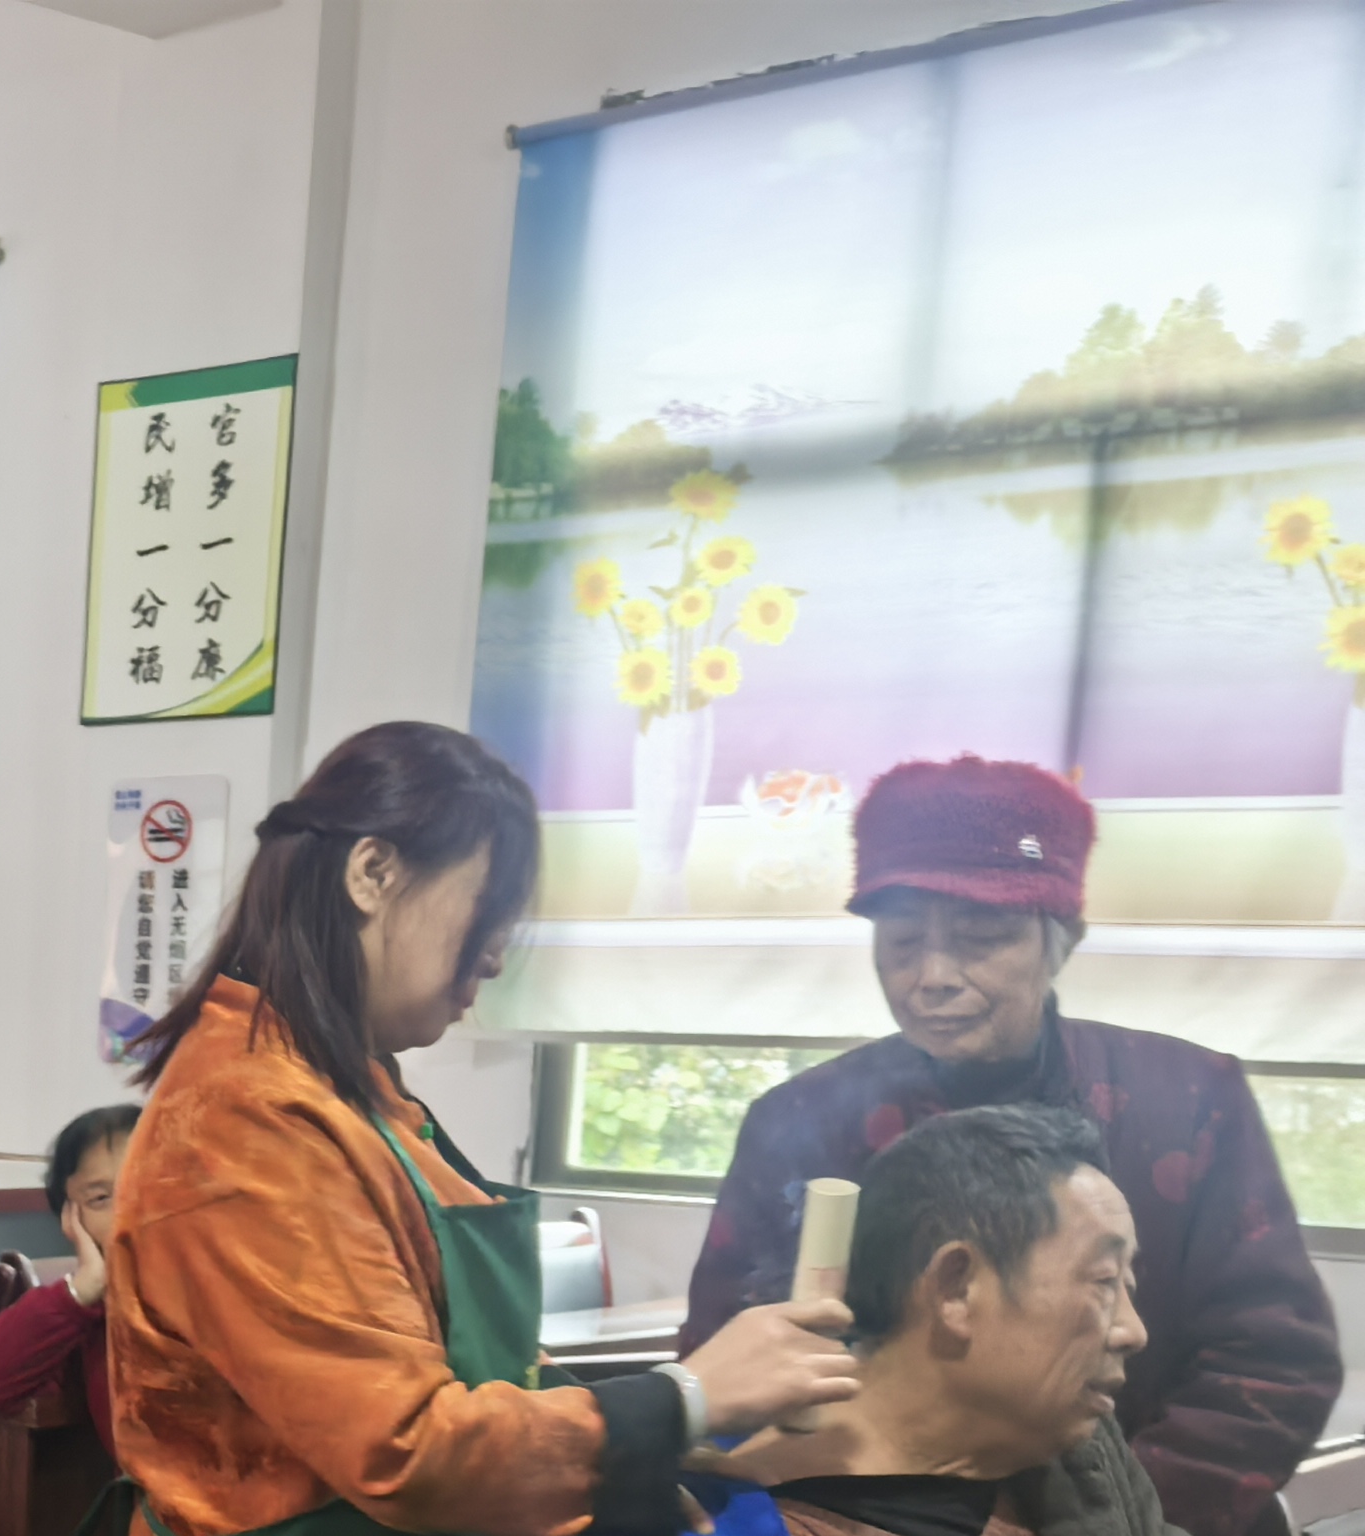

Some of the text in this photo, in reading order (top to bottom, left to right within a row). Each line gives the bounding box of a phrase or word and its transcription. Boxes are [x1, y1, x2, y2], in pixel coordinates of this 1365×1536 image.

[128, 410, 177, 687] 民增一分福
[191, 402, 243, 684] 官多一分廉
